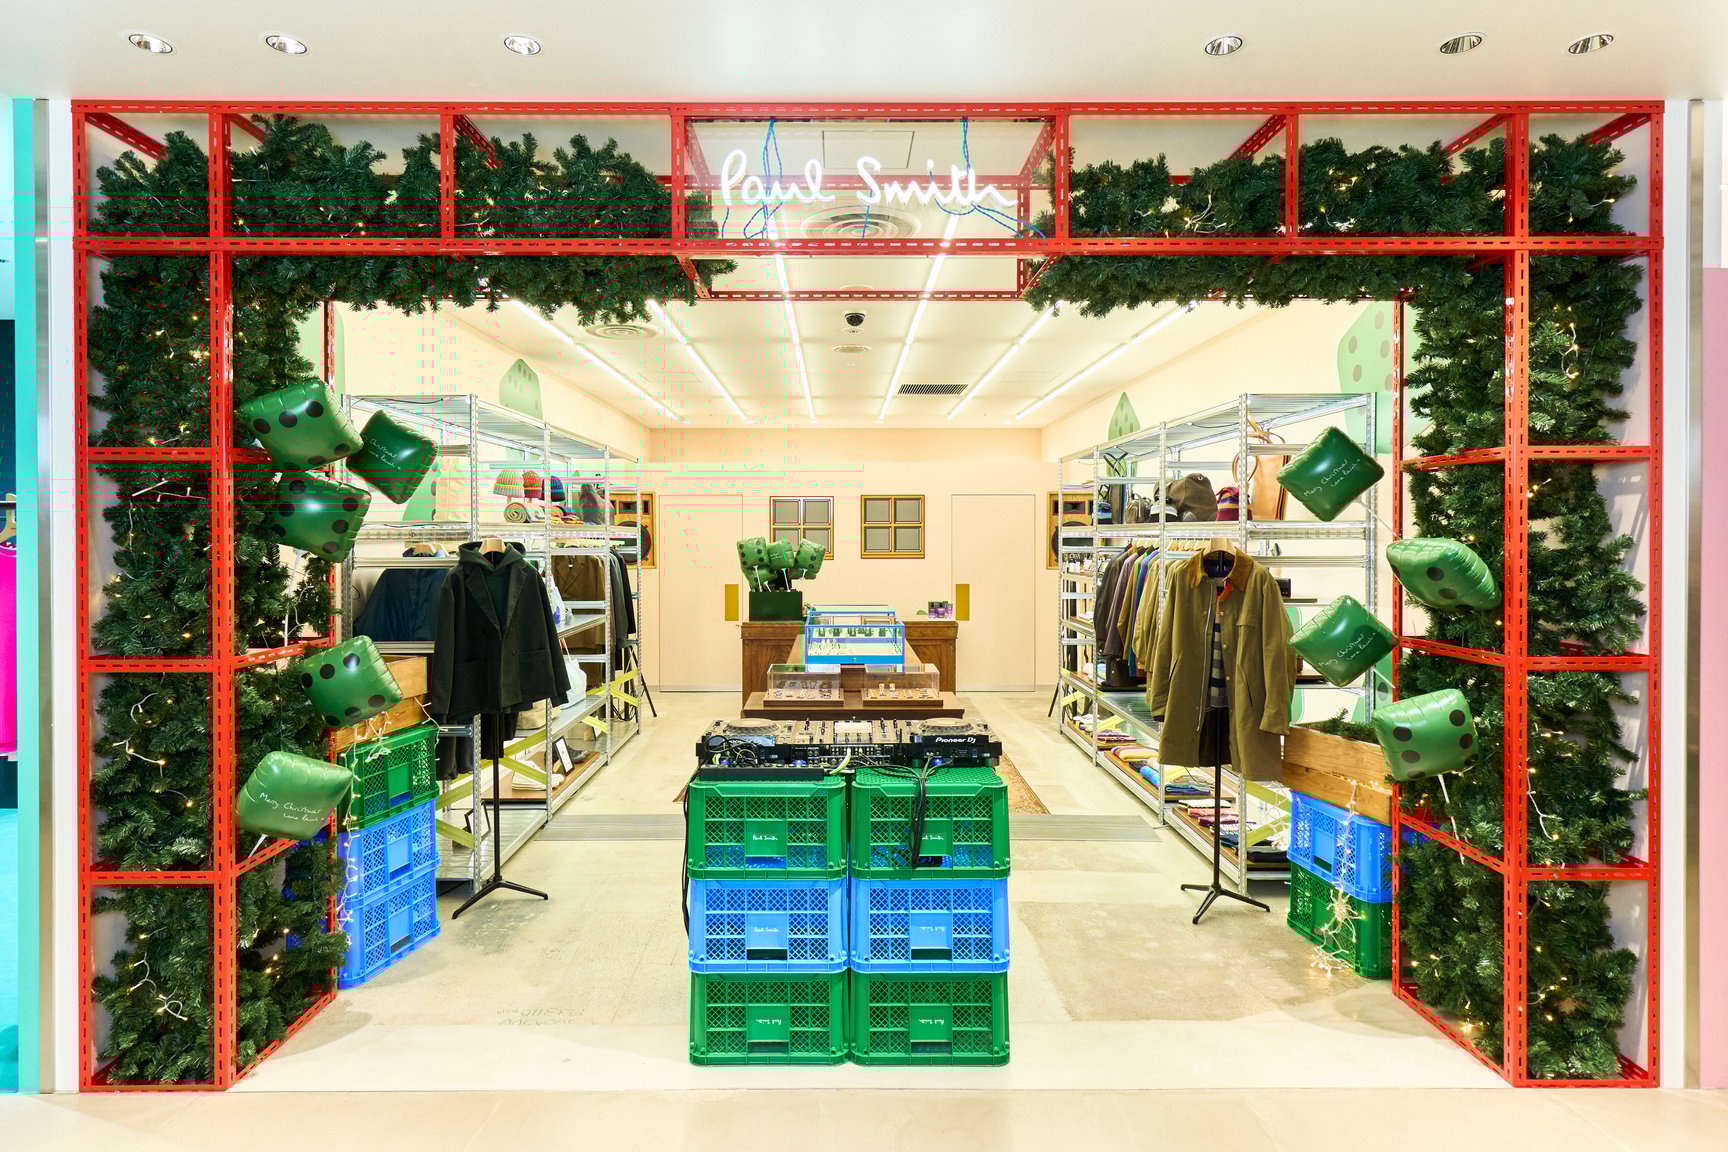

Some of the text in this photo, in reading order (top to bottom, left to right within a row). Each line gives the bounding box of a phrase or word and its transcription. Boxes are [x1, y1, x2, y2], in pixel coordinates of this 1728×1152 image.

[721, 149, 1018, 207] Paul Smith
[1303, 459, 1348, 497] Merry Christmas
[1318, 633, 1364, 666] Merry Christmas
[259, 792, 322, 814] Merry Christmas
